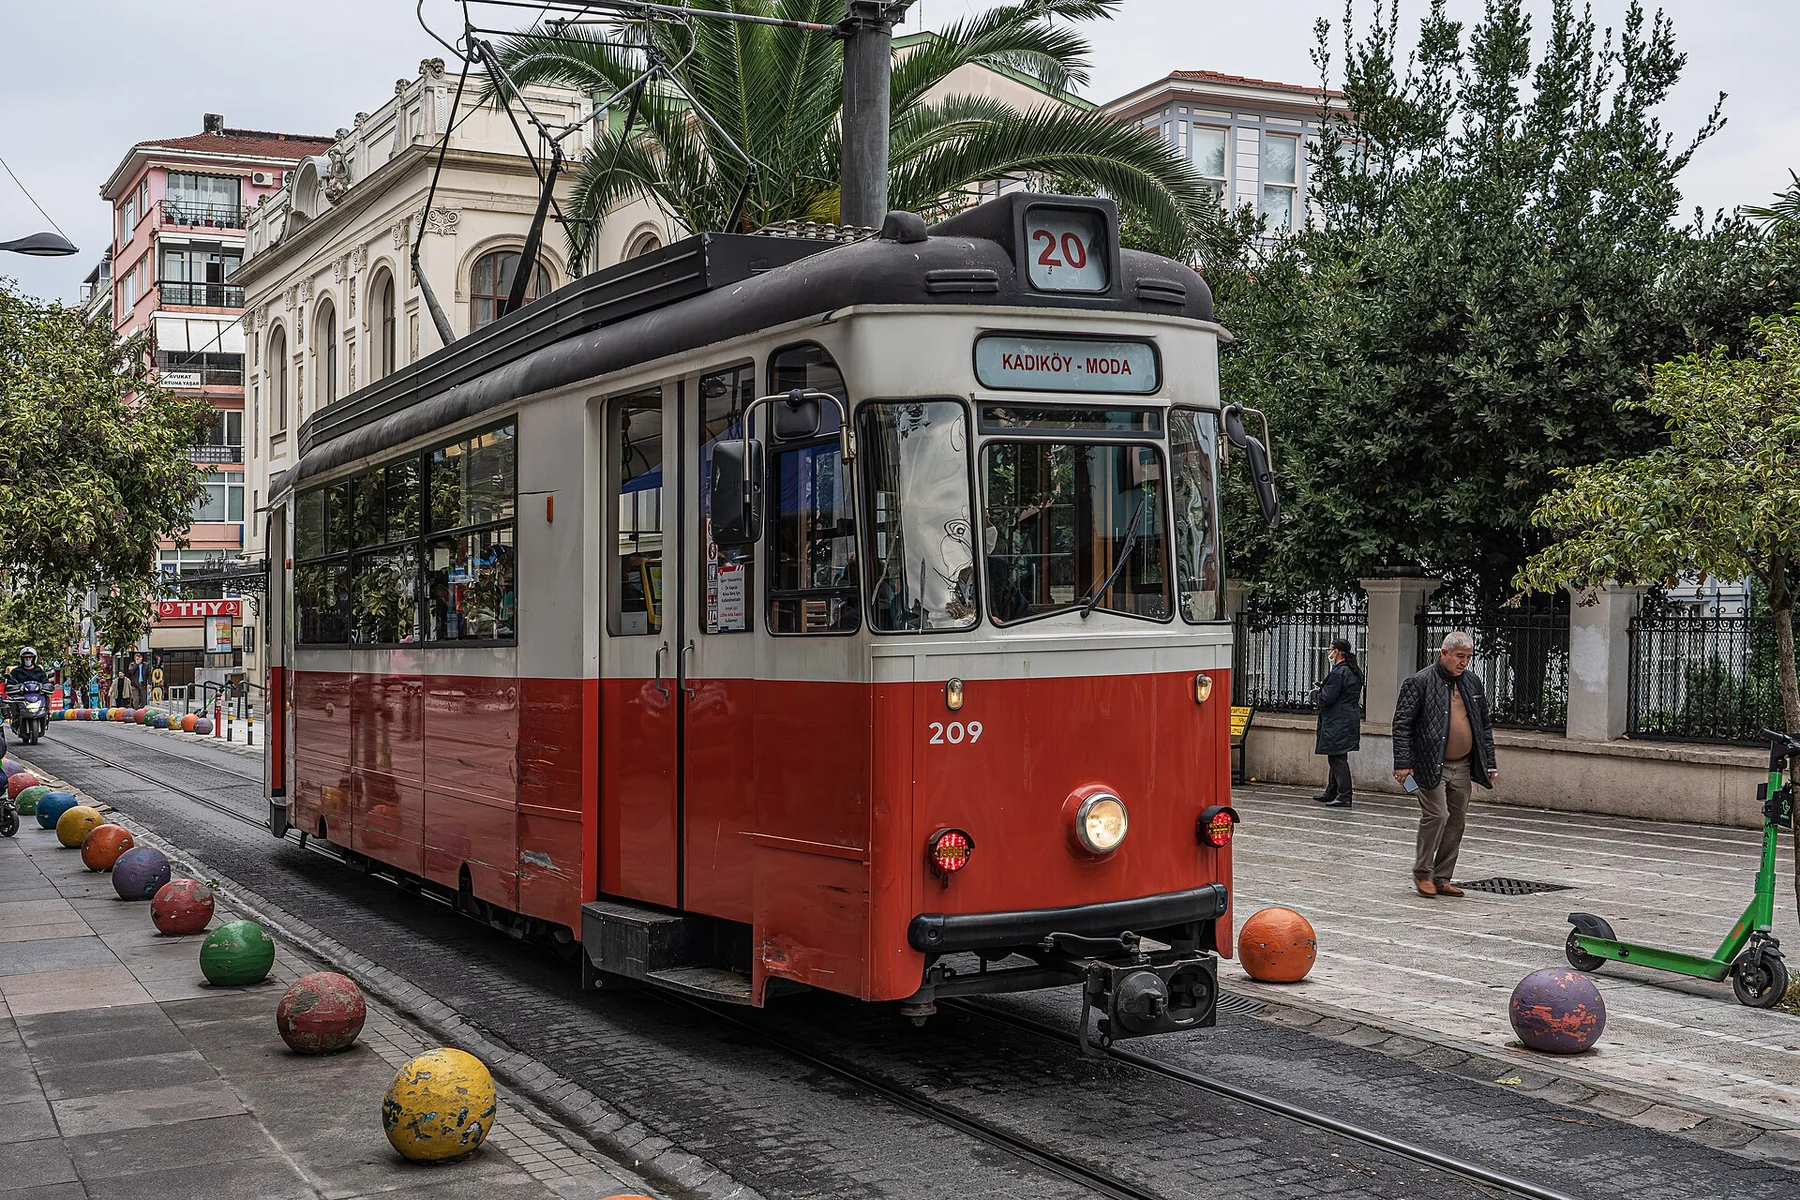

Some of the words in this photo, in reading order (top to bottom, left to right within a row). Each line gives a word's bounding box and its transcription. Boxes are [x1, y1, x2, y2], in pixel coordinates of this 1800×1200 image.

[1032, 229, 1088, 269] 20
[1002, 353, 1072, 373] KADIKÖY
[1086, 358, 1133, 375] MODA
[177, 602, 223, 616] THY
[929, 721, 983, 745] 209
